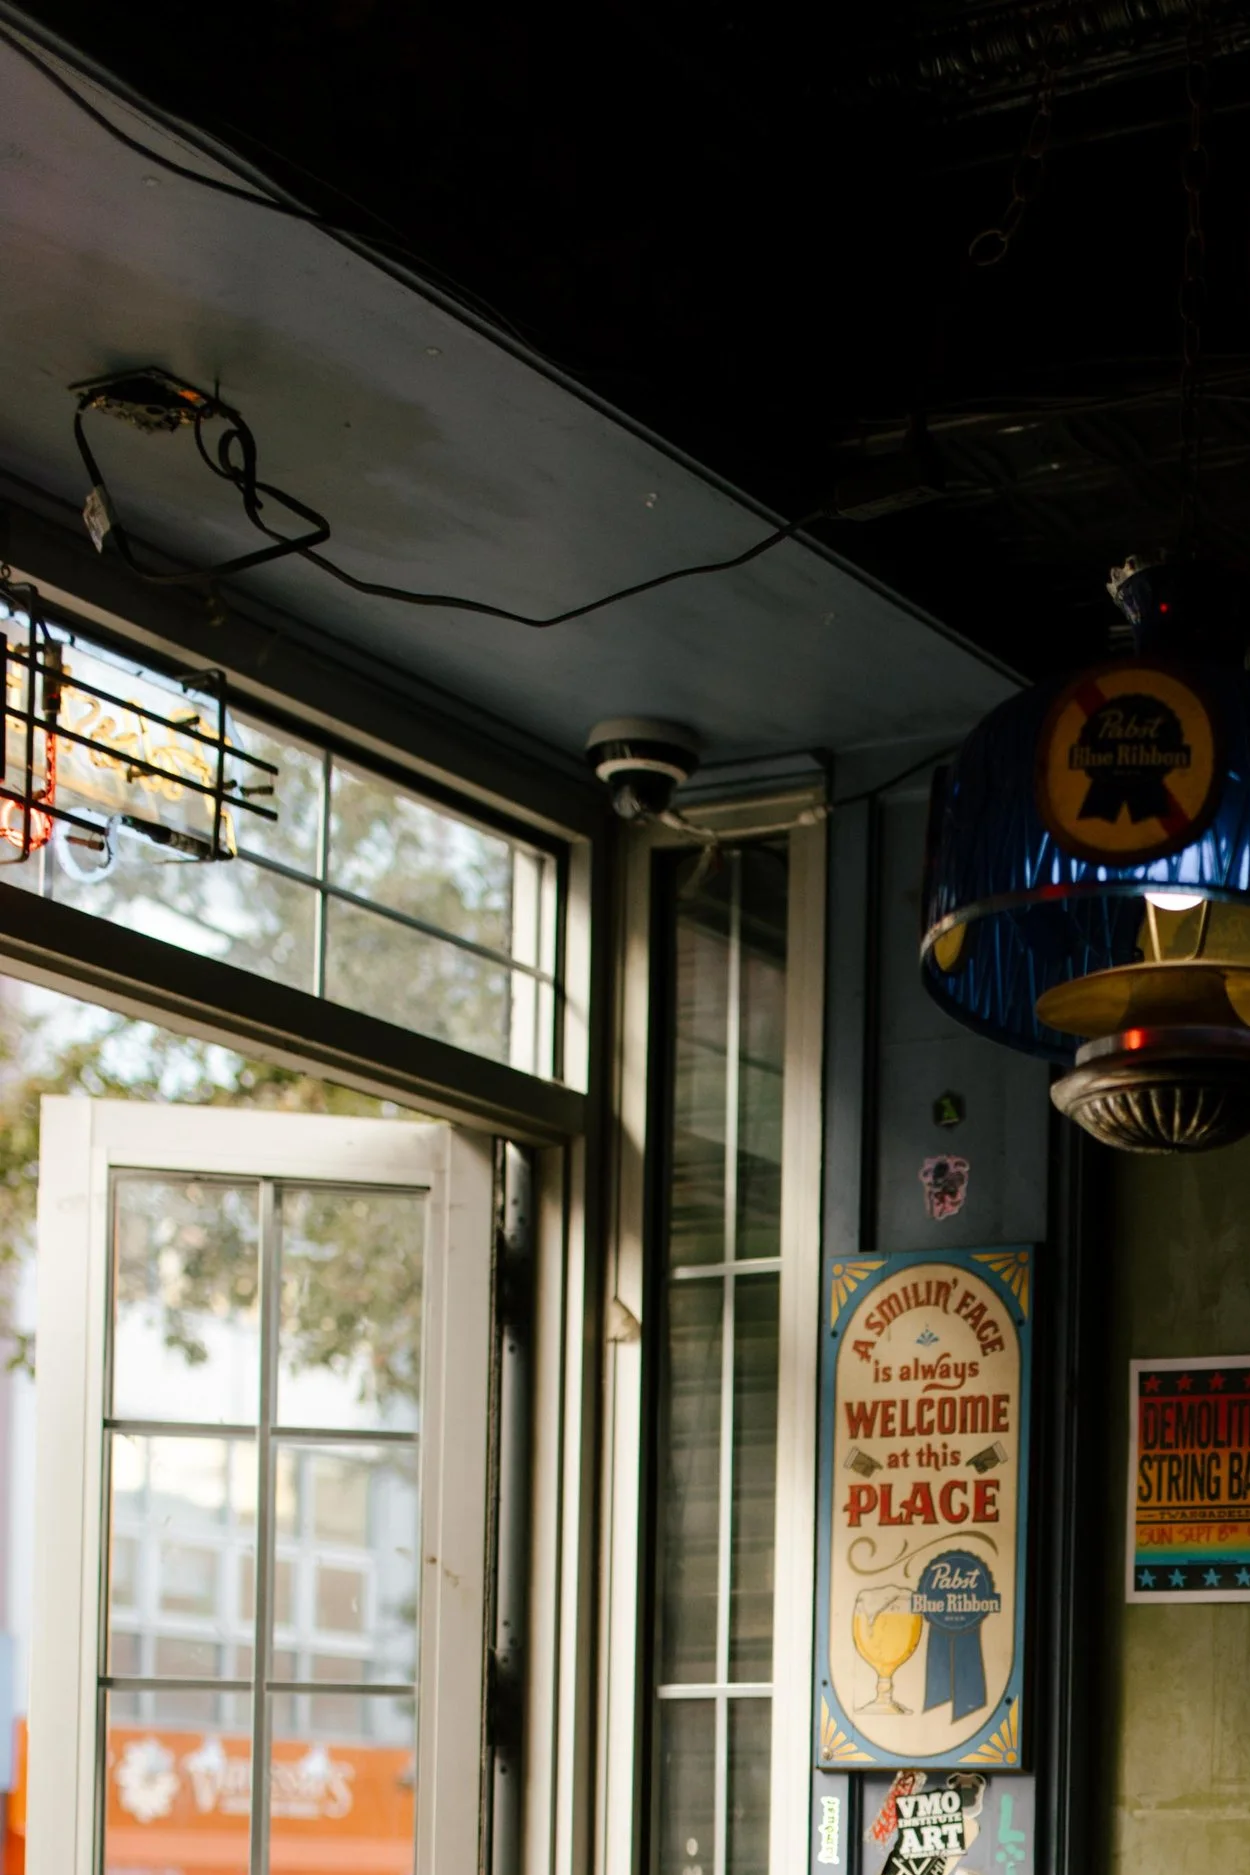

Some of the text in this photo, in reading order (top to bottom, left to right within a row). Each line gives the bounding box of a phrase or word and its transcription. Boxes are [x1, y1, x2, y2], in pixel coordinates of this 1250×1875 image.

[1097, 708, 1164, 741] Pabst
[1071, 744, 1189, 767] Blue Ribbon
[852, 1338, 877, 1363] A
[953, 1289, 1006, 1357] FACE
[873, 1352, 979, 1393] is always
[844, 1394, 1011, 1439] WELCOME
[887, 1442, 961, 1472] at this
[1138, 1453, 1221, 1503] STRING
[843, 1479, 1000, 1527] PLACE
[930, 1562, 981, 1590] Pabst
[912, 1592, 999, 1613] Blue Ribbon
[896, 1790, 961, 1819] VMO
[899, 1823, 964, 1854] ART
